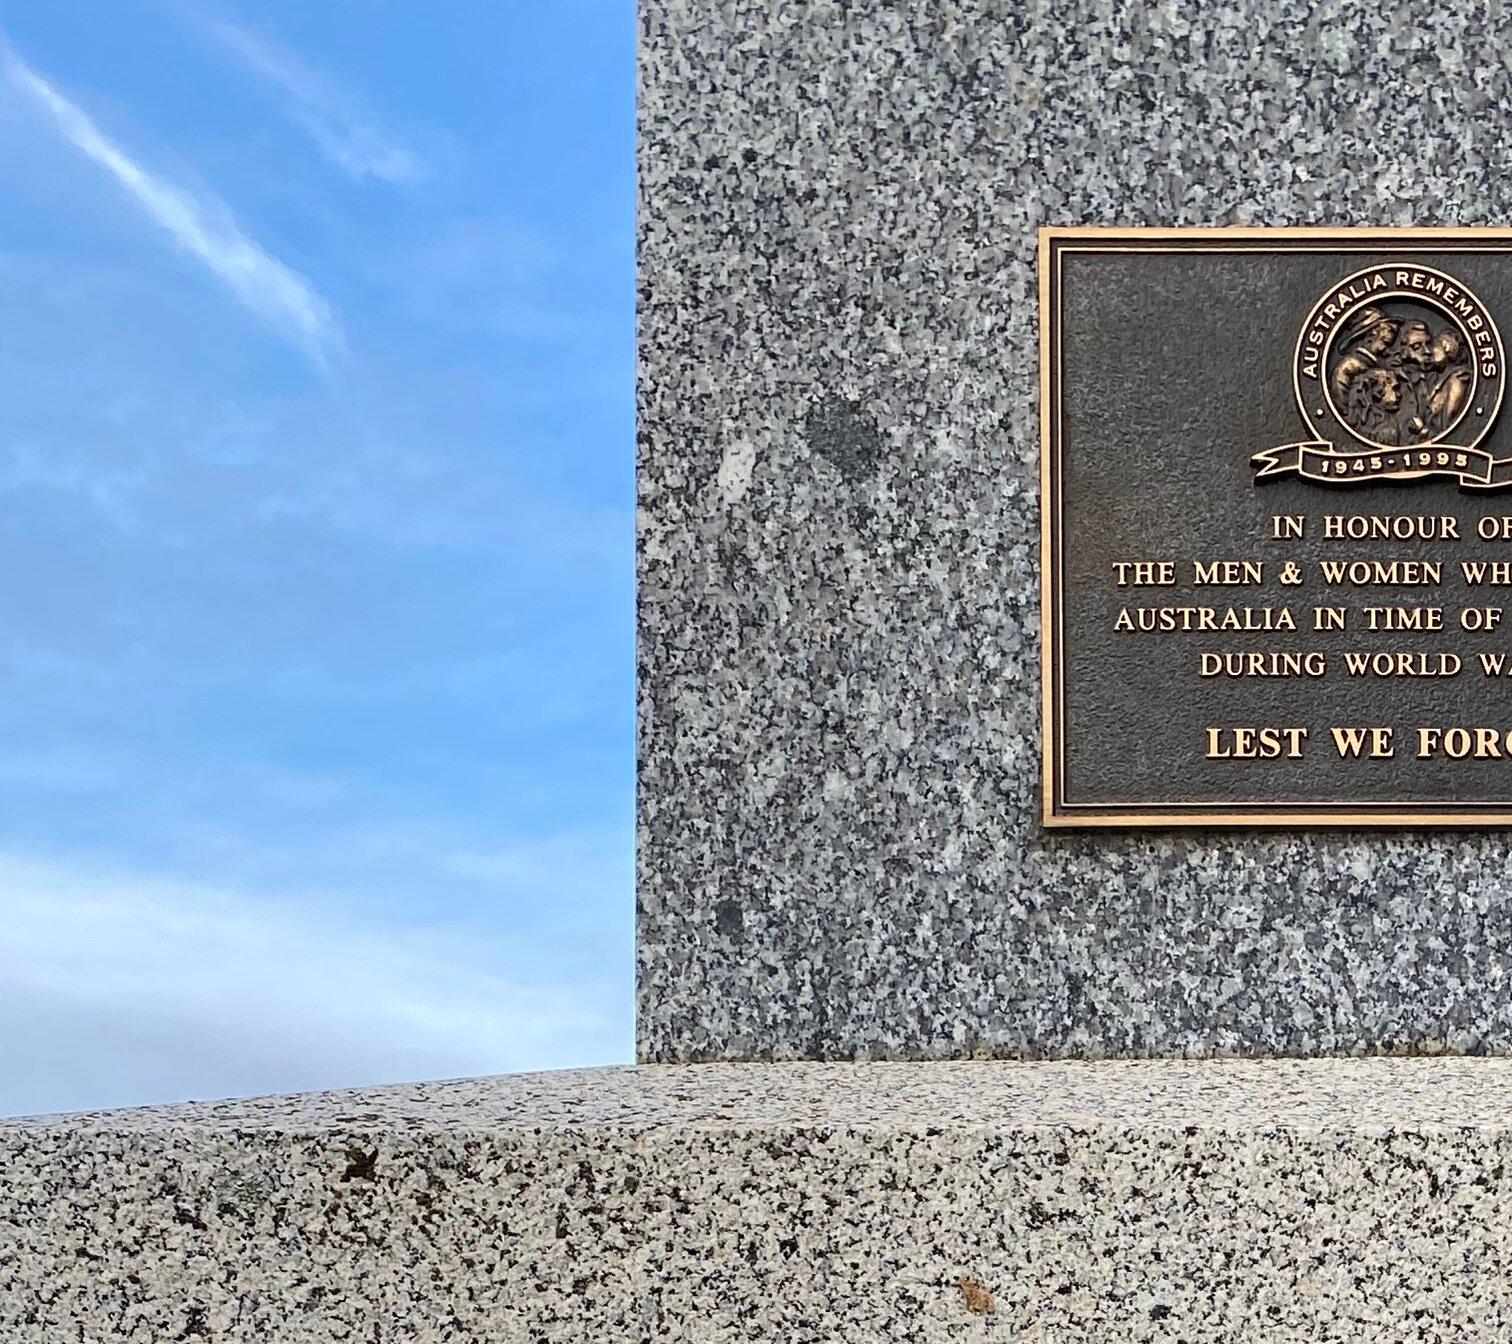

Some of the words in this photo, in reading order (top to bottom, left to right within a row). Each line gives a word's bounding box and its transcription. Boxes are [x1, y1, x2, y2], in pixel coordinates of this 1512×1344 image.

[1302, 273, 1387, 378] AUSTRALIA
[1395, 270, 1497, 378] REMEMBERS
[1272, 515, 1304, 539] IN
[1323, 515, 1459, 540] HONOUR
[1113, 561, 1176, 585] THE
[1193, 561, 1263, 585] MEN
[1280, 561, 1303, 585] &
[1320, 561, 1442, 585] WOMEN
[1113, 606, 1297, 632] AUSTRALIA
[1314, 607, 1346, 631] IN
[1363, 607, 1444, 631] TIME
[1459, 607, 1503, 632] OF
[1200, 652, 1326, 677] DURING
[1344, 652, 1462, 677] WORLD
[1206, 727, 1307, 758] LEST
[1331, 727, 1394, 758] WE
